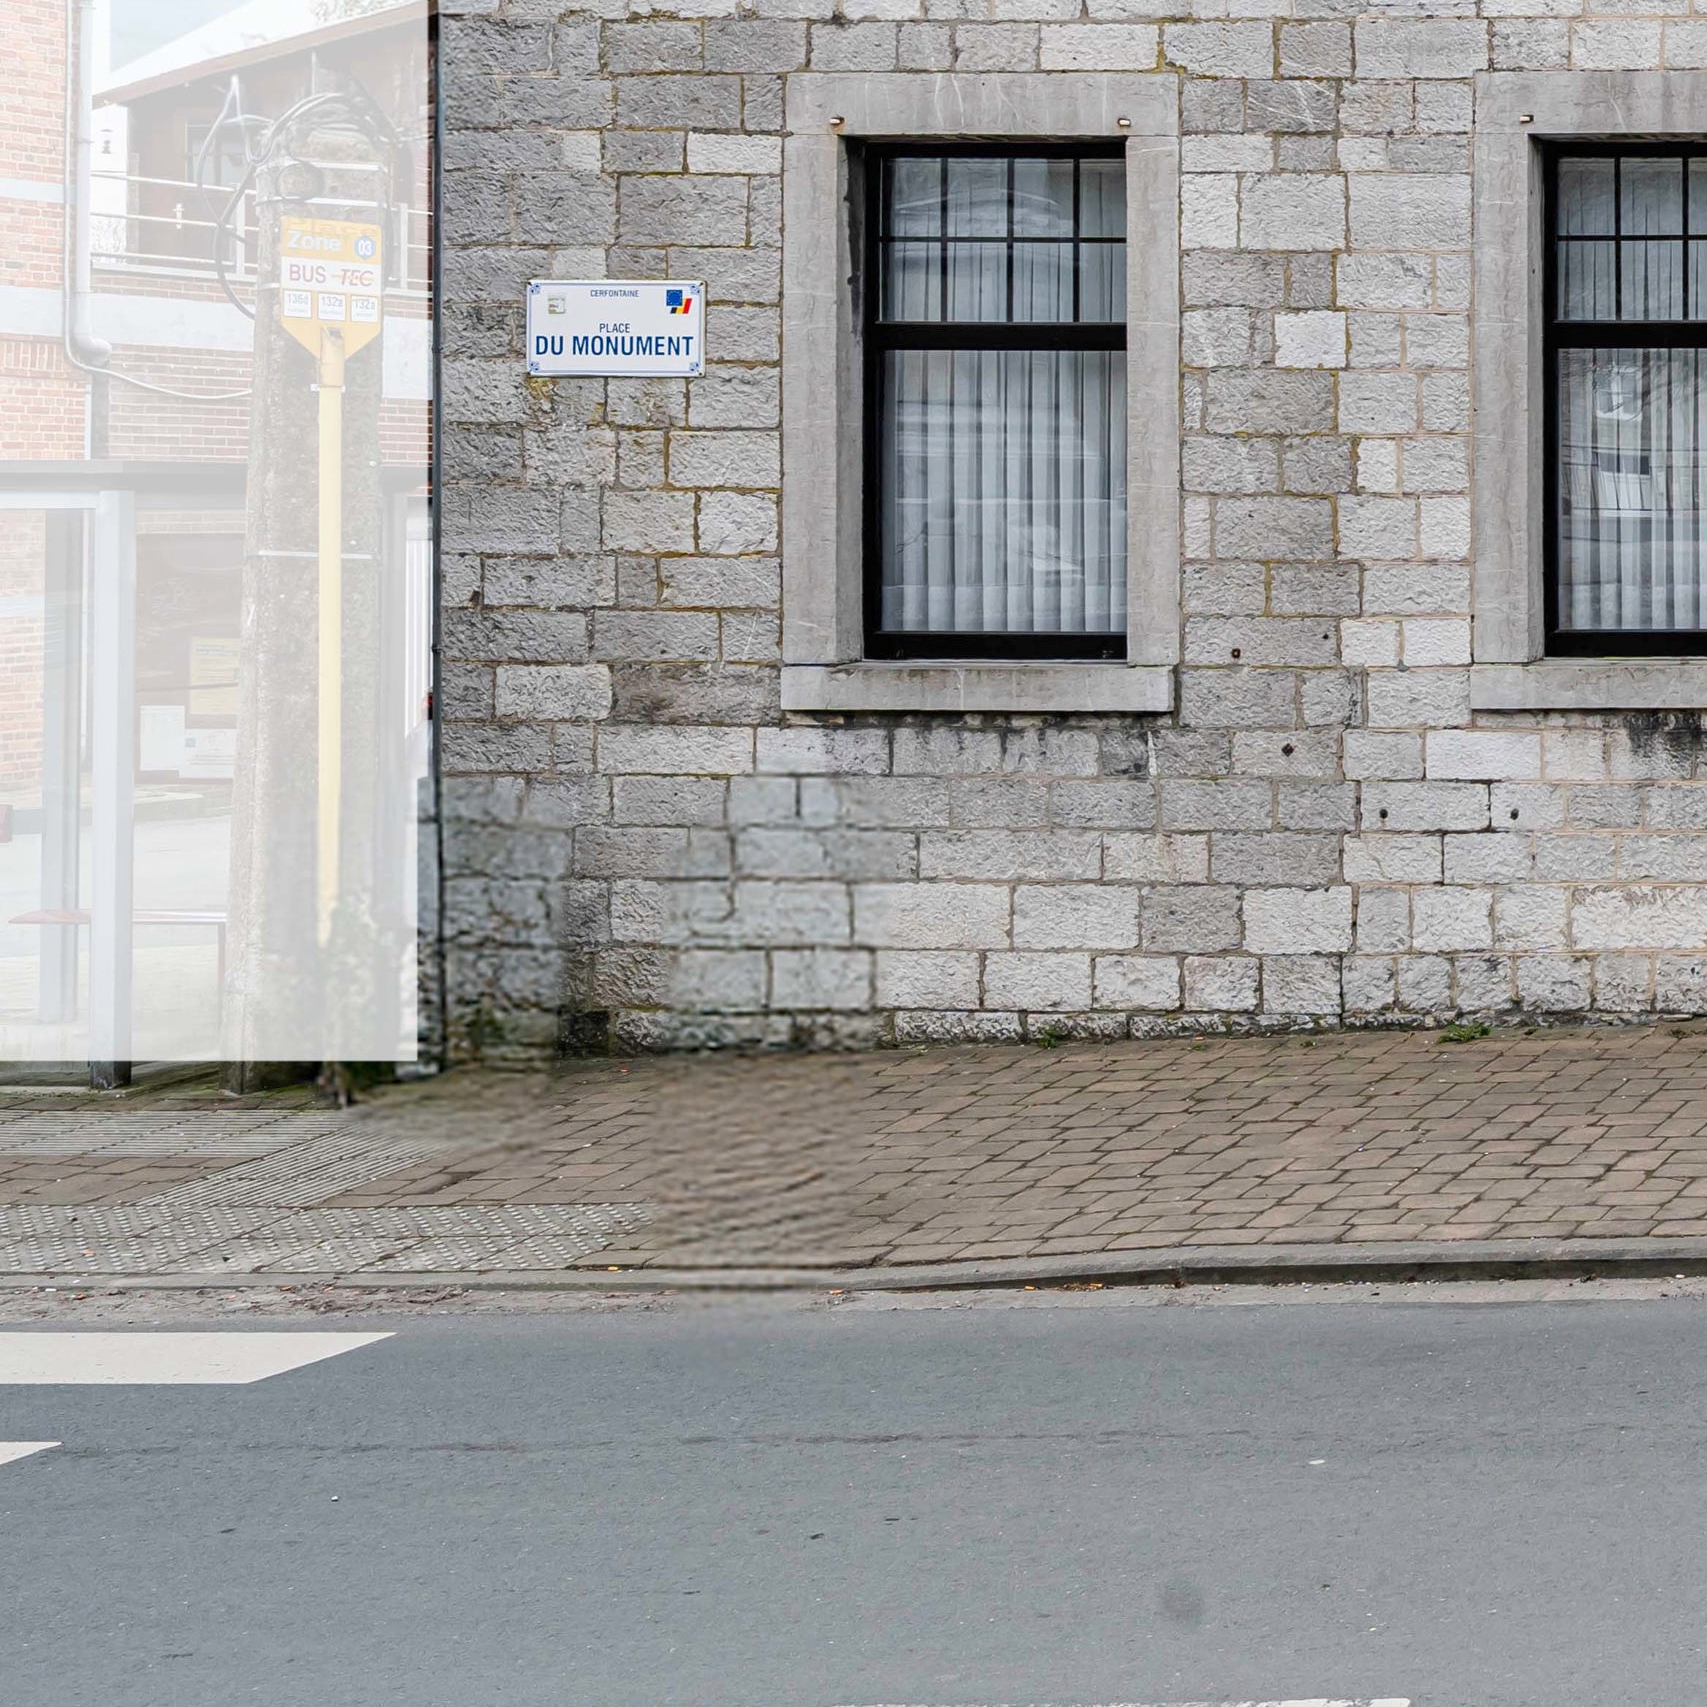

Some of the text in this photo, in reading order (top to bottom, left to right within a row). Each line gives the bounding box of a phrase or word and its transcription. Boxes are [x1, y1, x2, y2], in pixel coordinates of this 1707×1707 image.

[288, 229, 372, 256] Zone 03
[289, 263, 374, 287] BUS TEC
[590, 289, 639, 298] CERFONTAINE
[599, 323, 631, 334] PLACE
[535, 335, 694, 356] DU MONUMENT
